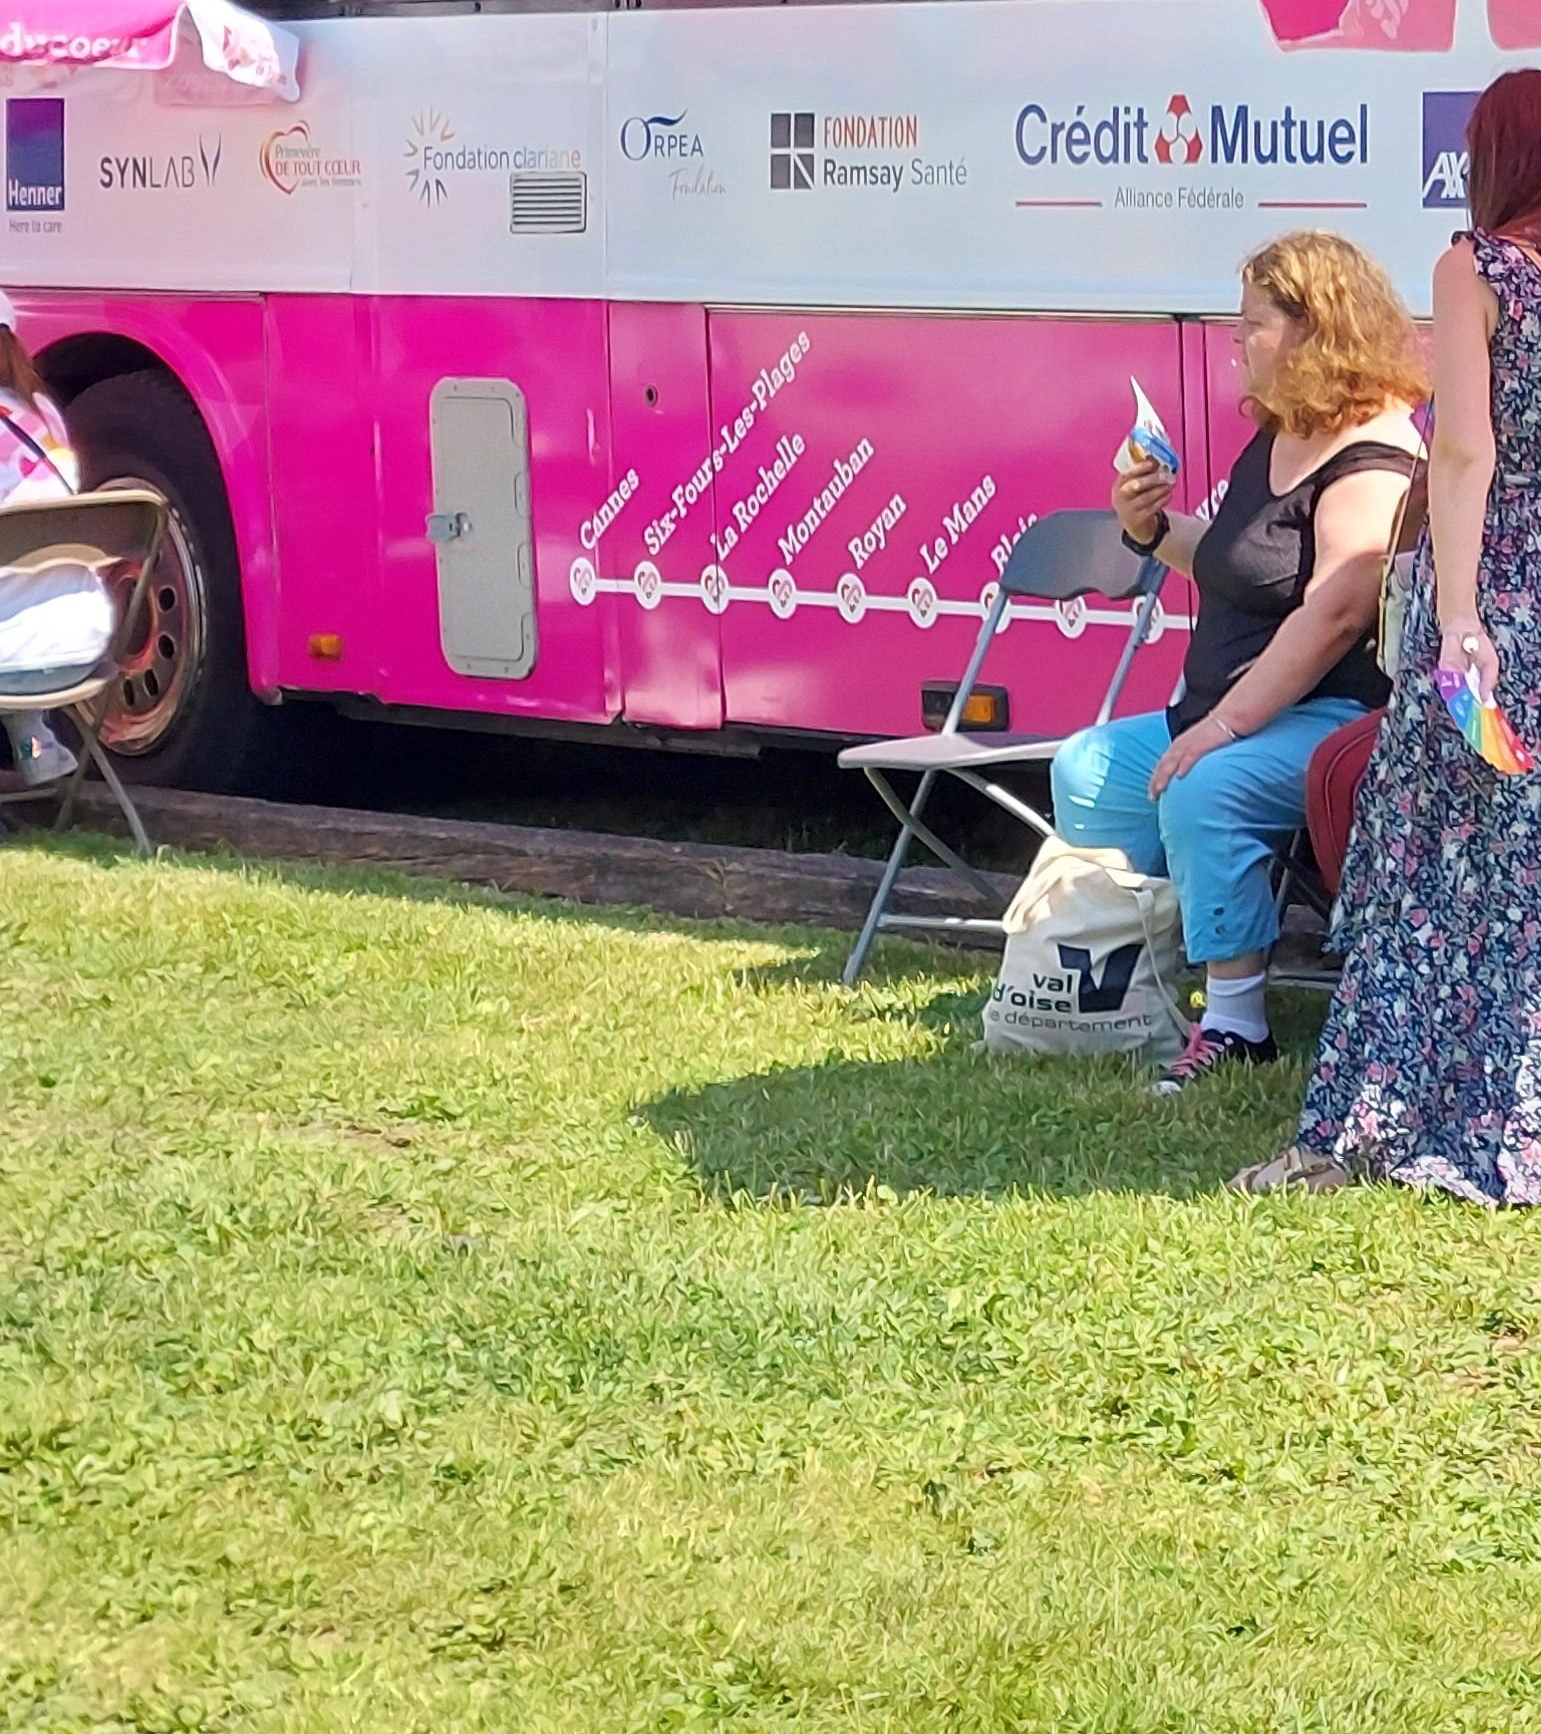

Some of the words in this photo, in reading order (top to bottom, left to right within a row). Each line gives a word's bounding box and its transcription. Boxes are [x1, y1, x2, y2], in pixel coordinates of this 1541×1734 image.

[620, 116, 704, 161] ORPEA
[824, 114, 918, 149] FONDATION
[1015, 103, 1150, 167] Crédit
[1211, 102, 1370, 166] Mutuel
[100, 155, 196, 189] SYNLAB
[275, 161, 290, 177] DE
[293, 161, 321, 176] TOUT
[423, 144, 510, 171] Fondation
[513, 145, 581, 170] clariane
[823, 158, 904, 193] Ramsay
[910, 155, 968, 186] Santé
[8, 178, 63, 207] Henner
[1114, 186, 1174, 211] Alliance
[1177, 186, 1245, 211] Fédérale
[9, 219, 31, 234] Here
[43, 220, 63, 234] care
[643, 330, 811, 556] Six-Fours-Les-Plages
[580, 469, 640, 550] Cannes
[710, 525, 739, 561] La
[731, 433, 806, 533] Rochelle
[776, 437, 875, 566] Montauban
[847, 493, 907, 570] Royan
[919, 536, 949, 575] Le
[941, 474, 997, 545] Mans
[1032, 972, 1073, 994] val
[1004, 1010, 1152, 1033] département
